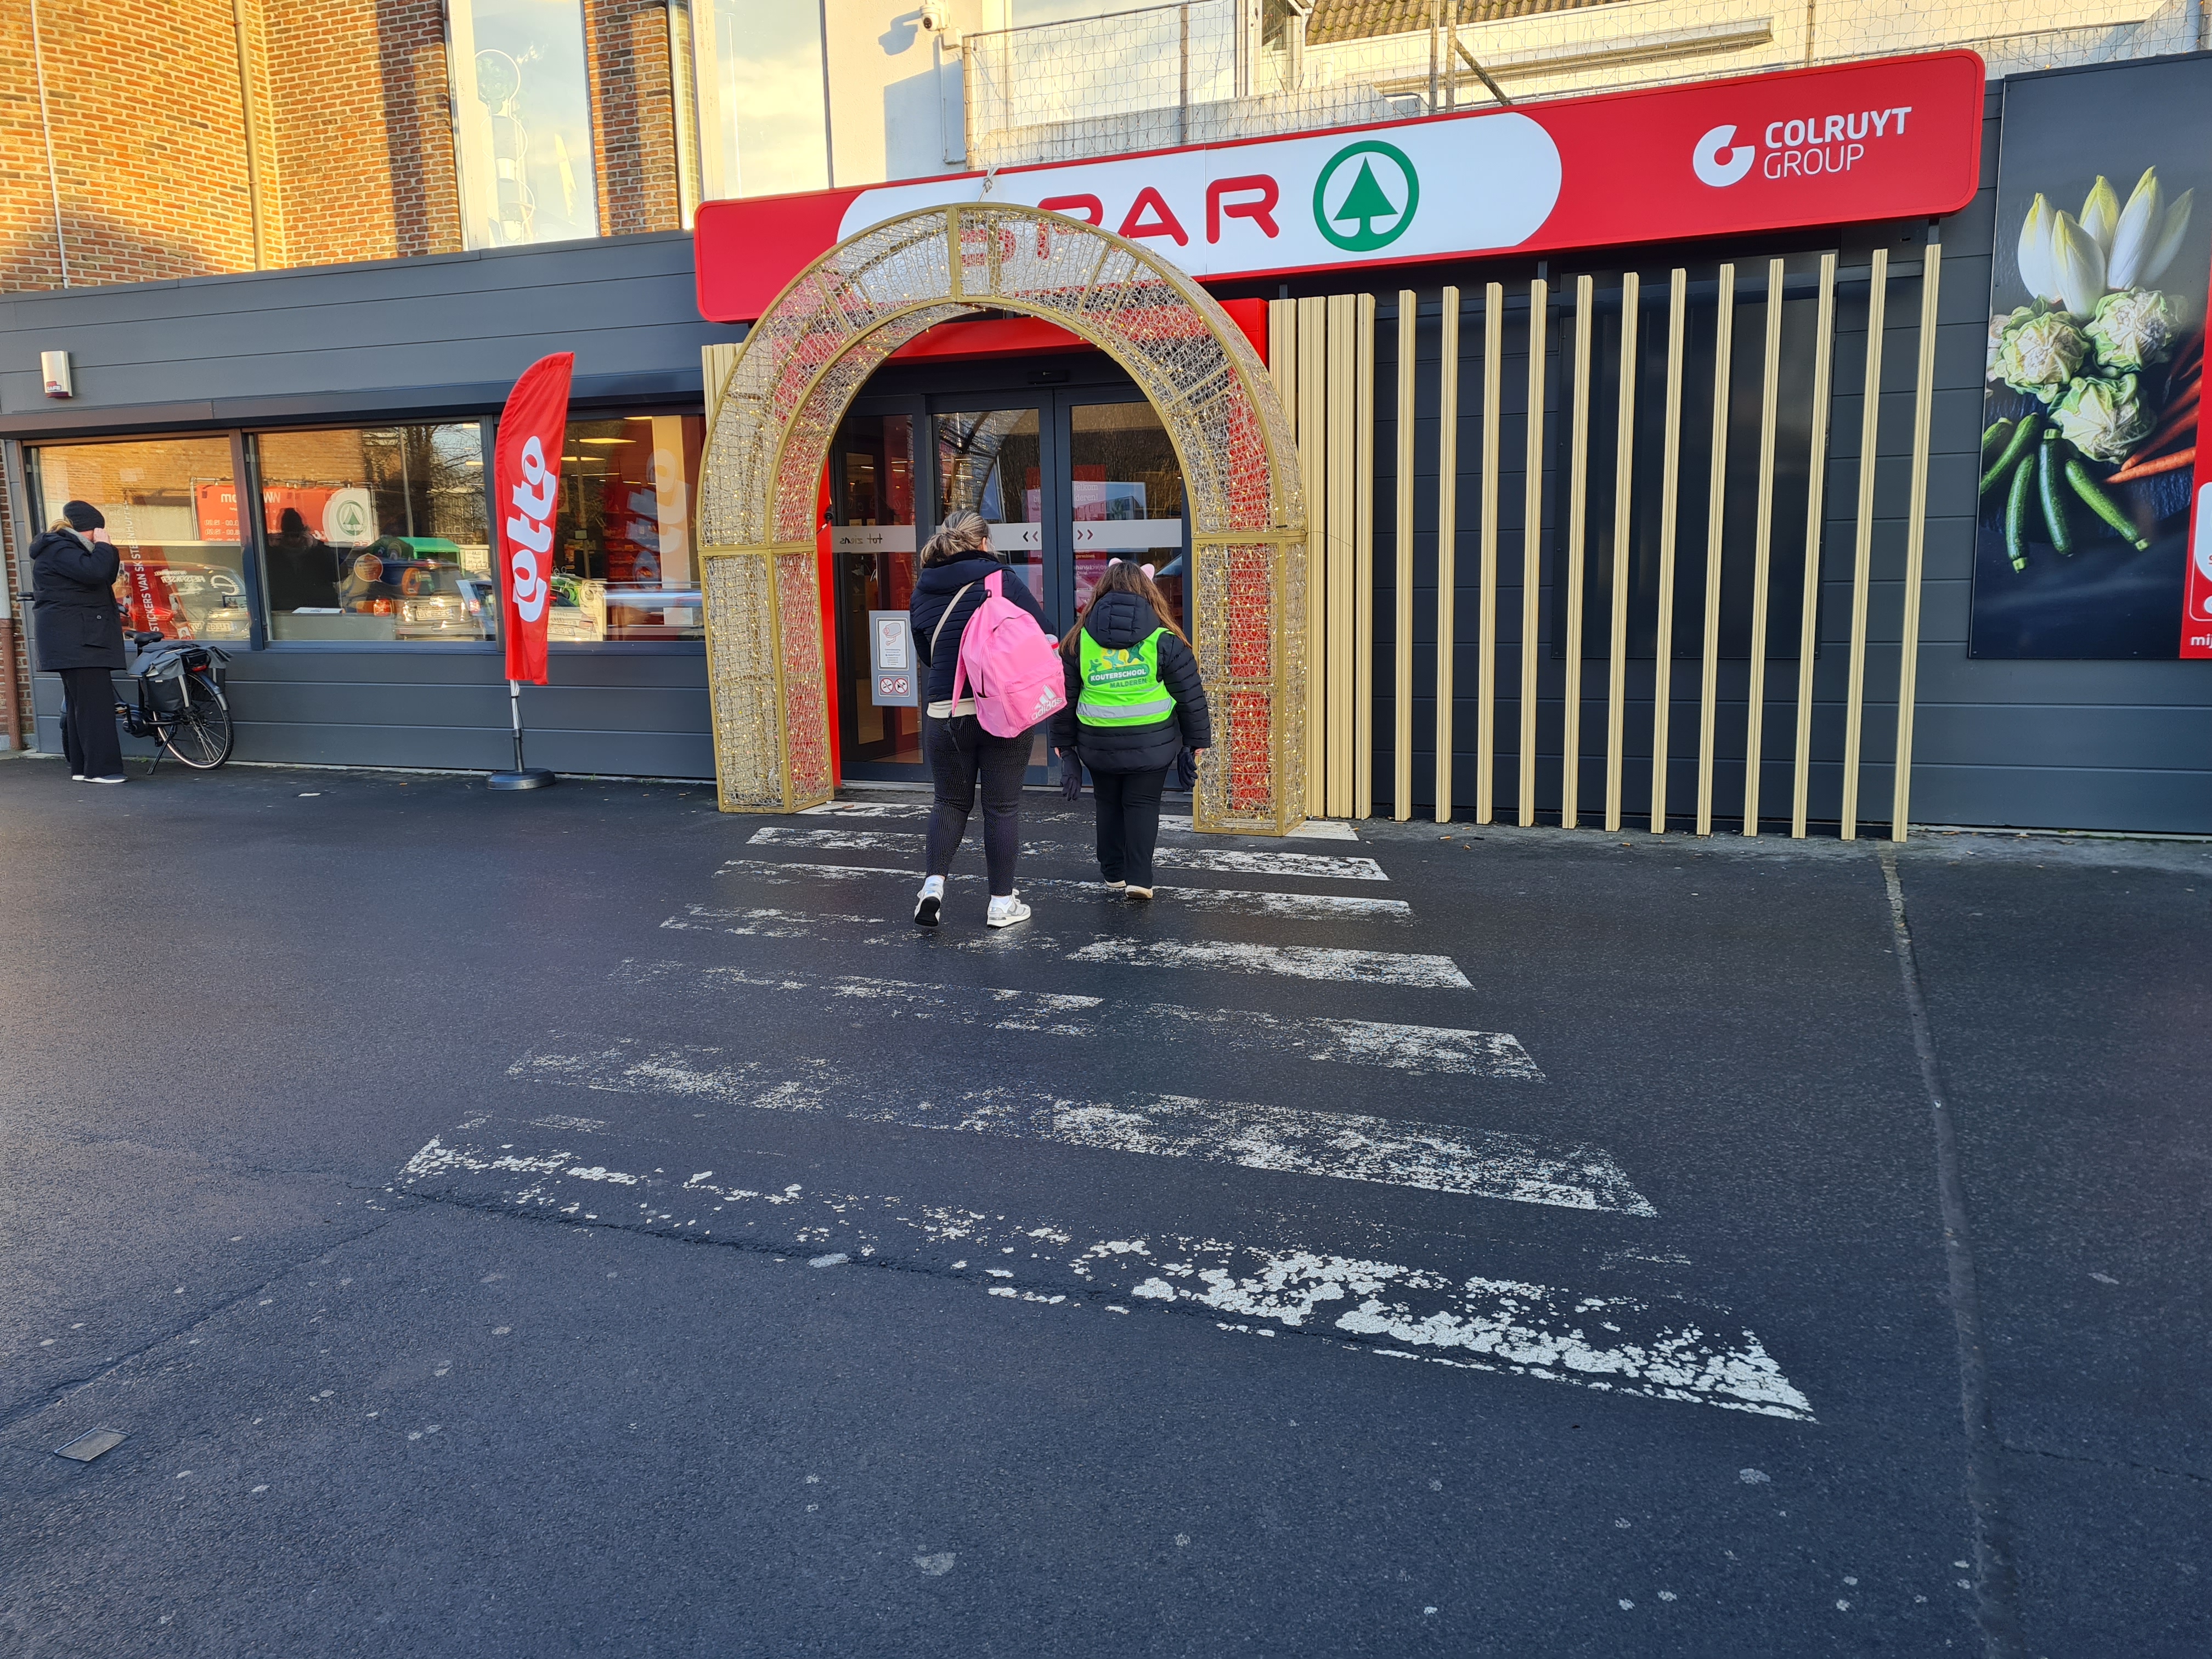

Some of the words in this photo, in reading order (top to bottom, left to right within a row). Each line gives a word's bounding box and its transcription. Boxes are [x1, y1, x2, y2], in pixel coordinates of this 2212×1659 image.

[1765, 106, 1912, 149] COLRUYT
[1763, 144, 1865, 179] GROUP
[134, 561, 144, 572] SK
[137, 573, 149, 592] VAN
[142, 593, 159, 631] STICKERS
[1091, 668, 1147, 681] KOUTERSCHOOL
[1109, 678, 1147, 689] MALDEREN
[1031, 697, 1063, 720] adidas
